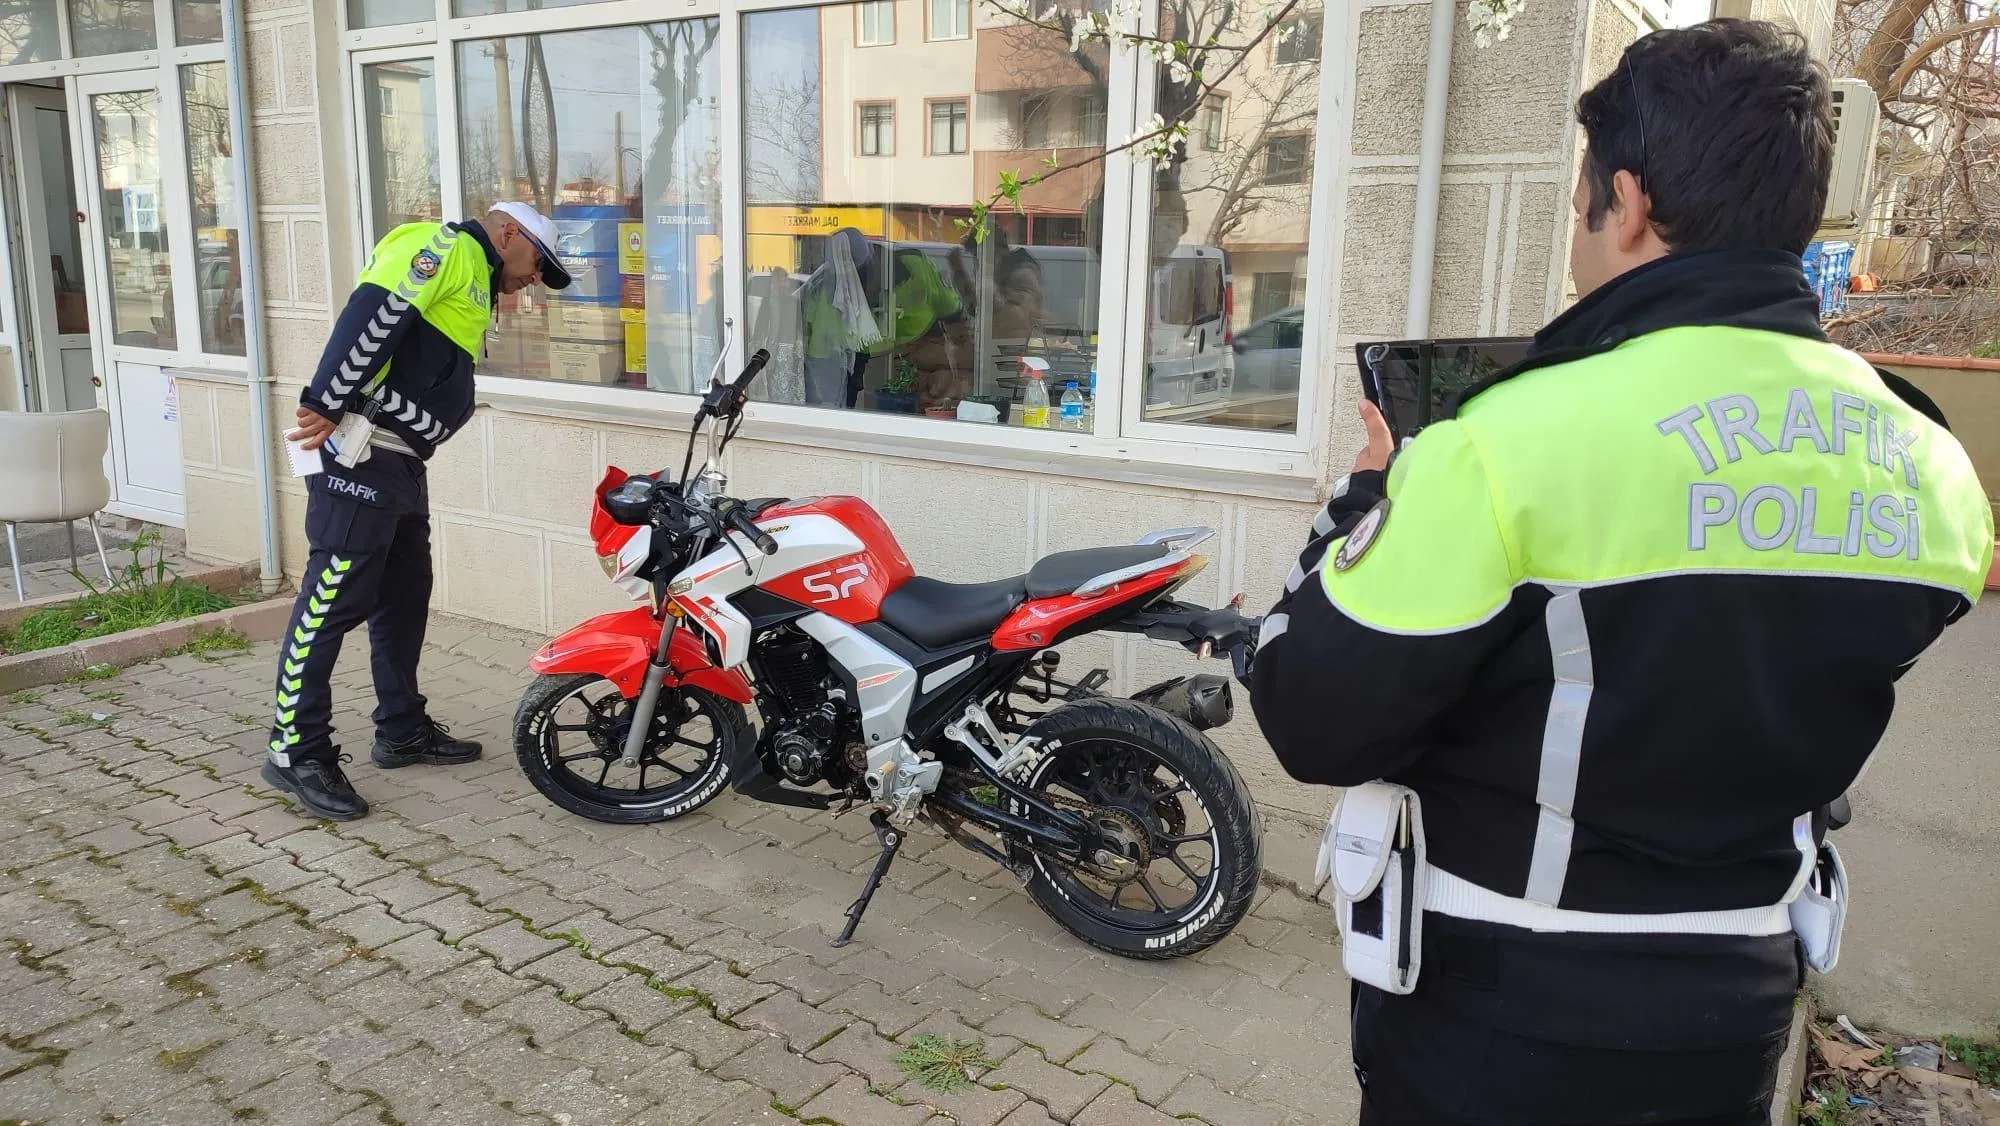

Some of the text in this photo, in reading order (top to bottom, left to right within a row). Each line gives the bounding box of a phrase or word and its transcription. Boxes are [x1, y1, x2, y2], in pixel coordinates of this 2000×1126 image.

[803, 562, 869, 604] SP
[663, 762, 730, 817] MICHELIN
[1144, 890, 1225, 949] MICHELIN
